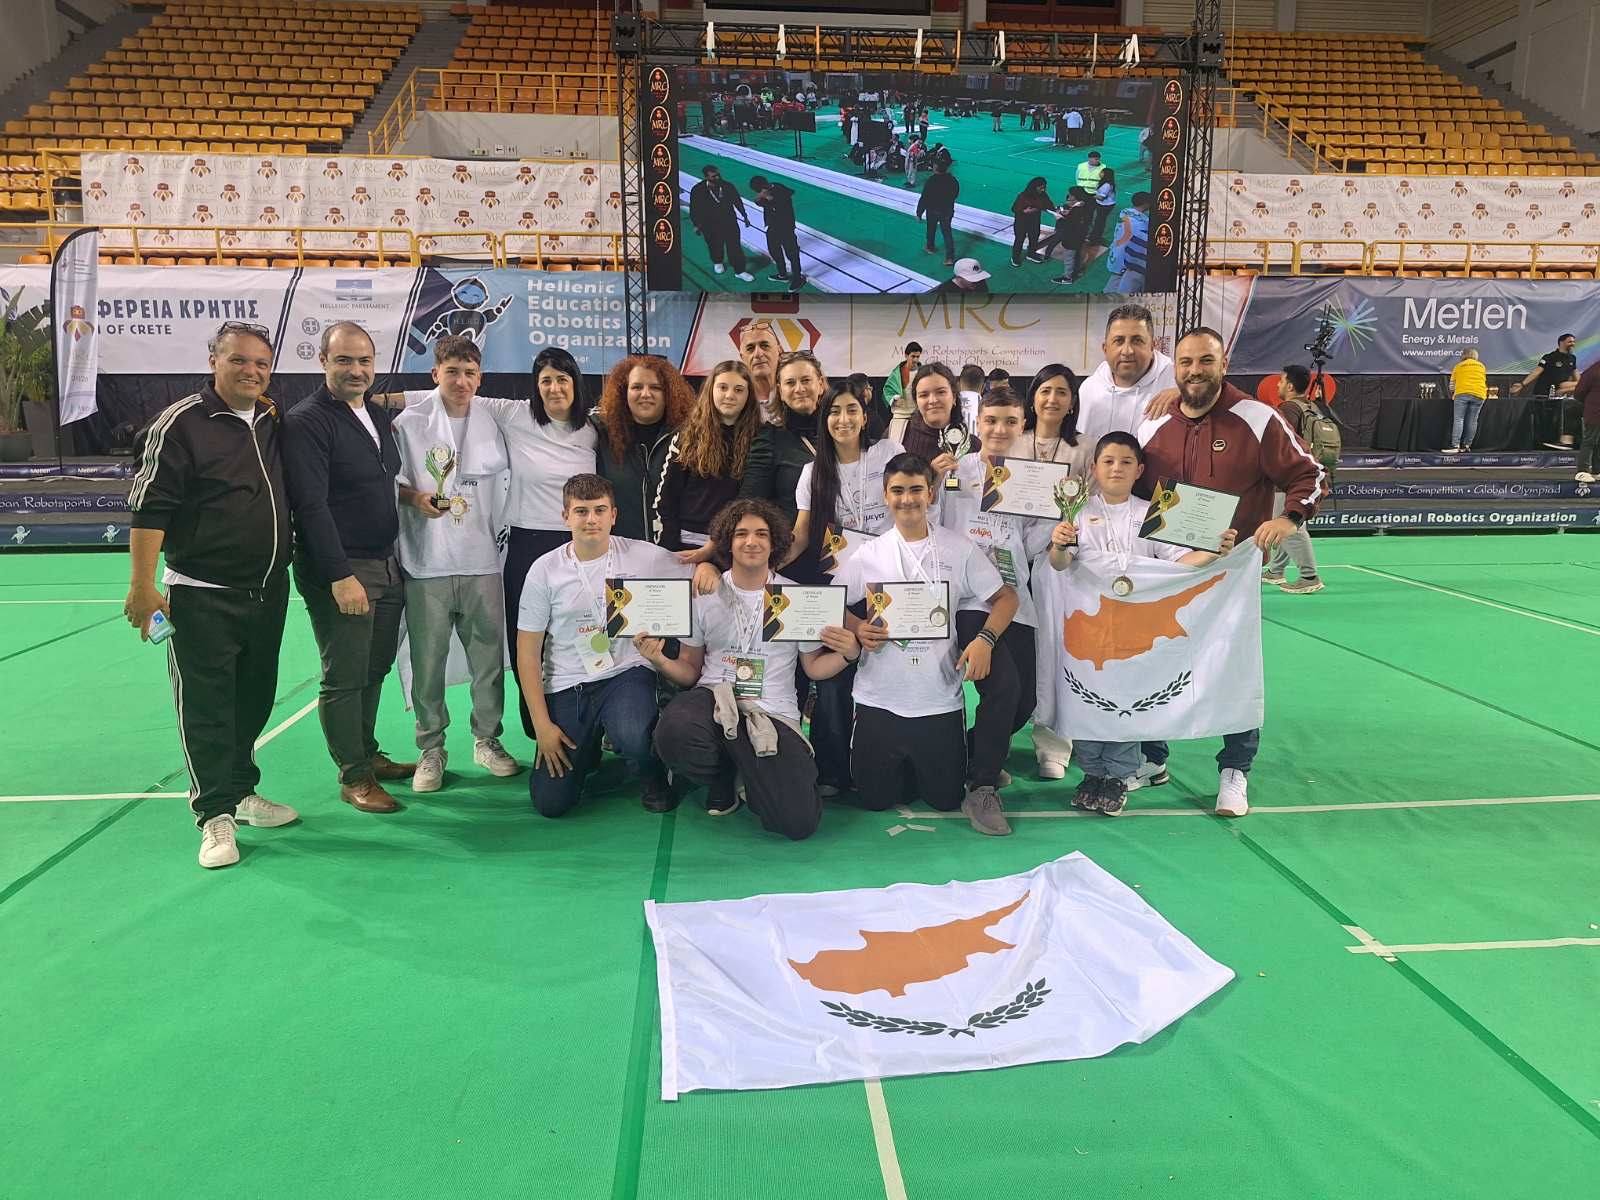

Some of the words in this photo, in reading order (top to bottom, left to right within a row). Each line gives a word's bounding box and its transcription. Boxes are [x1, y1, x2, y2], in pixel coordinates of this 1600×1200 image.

[651, 81, 667, 92] MRC
[1165, 93, 1180, 103] MRC
[652, 120, 667, 129] MRC
[1163, 129, 1178, 140] MRC
[352, 161, 384, 174] MRC
[653, 157, 668, 167] MRC
[419, 162, 450, 174] MRC
[481, 167, 511, 177] MRC
[1160, 166, 1176, 175] MRC
[317, 186, 346, 197] MRC
[381, 187, 410, 198] MRC
[446, 189, 473, 200] MRC
[654, 195, 671, 205] MRC
[1158, 201, 1174, 210] MRC
[289, 206, 318, 217] MRC
[419, 208, 450, 220] MRC
[655, 232, 671, 241] MRC
[1156, 237, 1171, 246] MRC
[528, 280, 615, 294] Hellenic
[179, 300, 259, 319] ΚΡΗΤΗΣ
[898, 293, 1040, 337] MRC
[1403, 297, 1527, 330] Metlen
[528, 312, 621, 329] Robotics
[106, 324, 125, 335] OF
[130, 324, 172, 335] CRETE
[1402, 334, 1435, 345] Energy
[1437, 334, 1446, 344] &
[1447, 334, 1479, 344] Metals
[932, 345, 989, 358] Robotsports
[992, 345, 1046, 358] Competition
[1348, 485, 1404, 497] Robotsports
[1408, 485, 1464, 496] Competition
[1474, 484, 1507, 495] Global
[1510, 484, 1561, 496] Olympiad
[23, 496, 91, 509] Robotsports
[1341, 513, 1422, 524] Educational
[1427, 512, 1485, 523] Robotics
[1490, 511, 1577, 525] Organization
